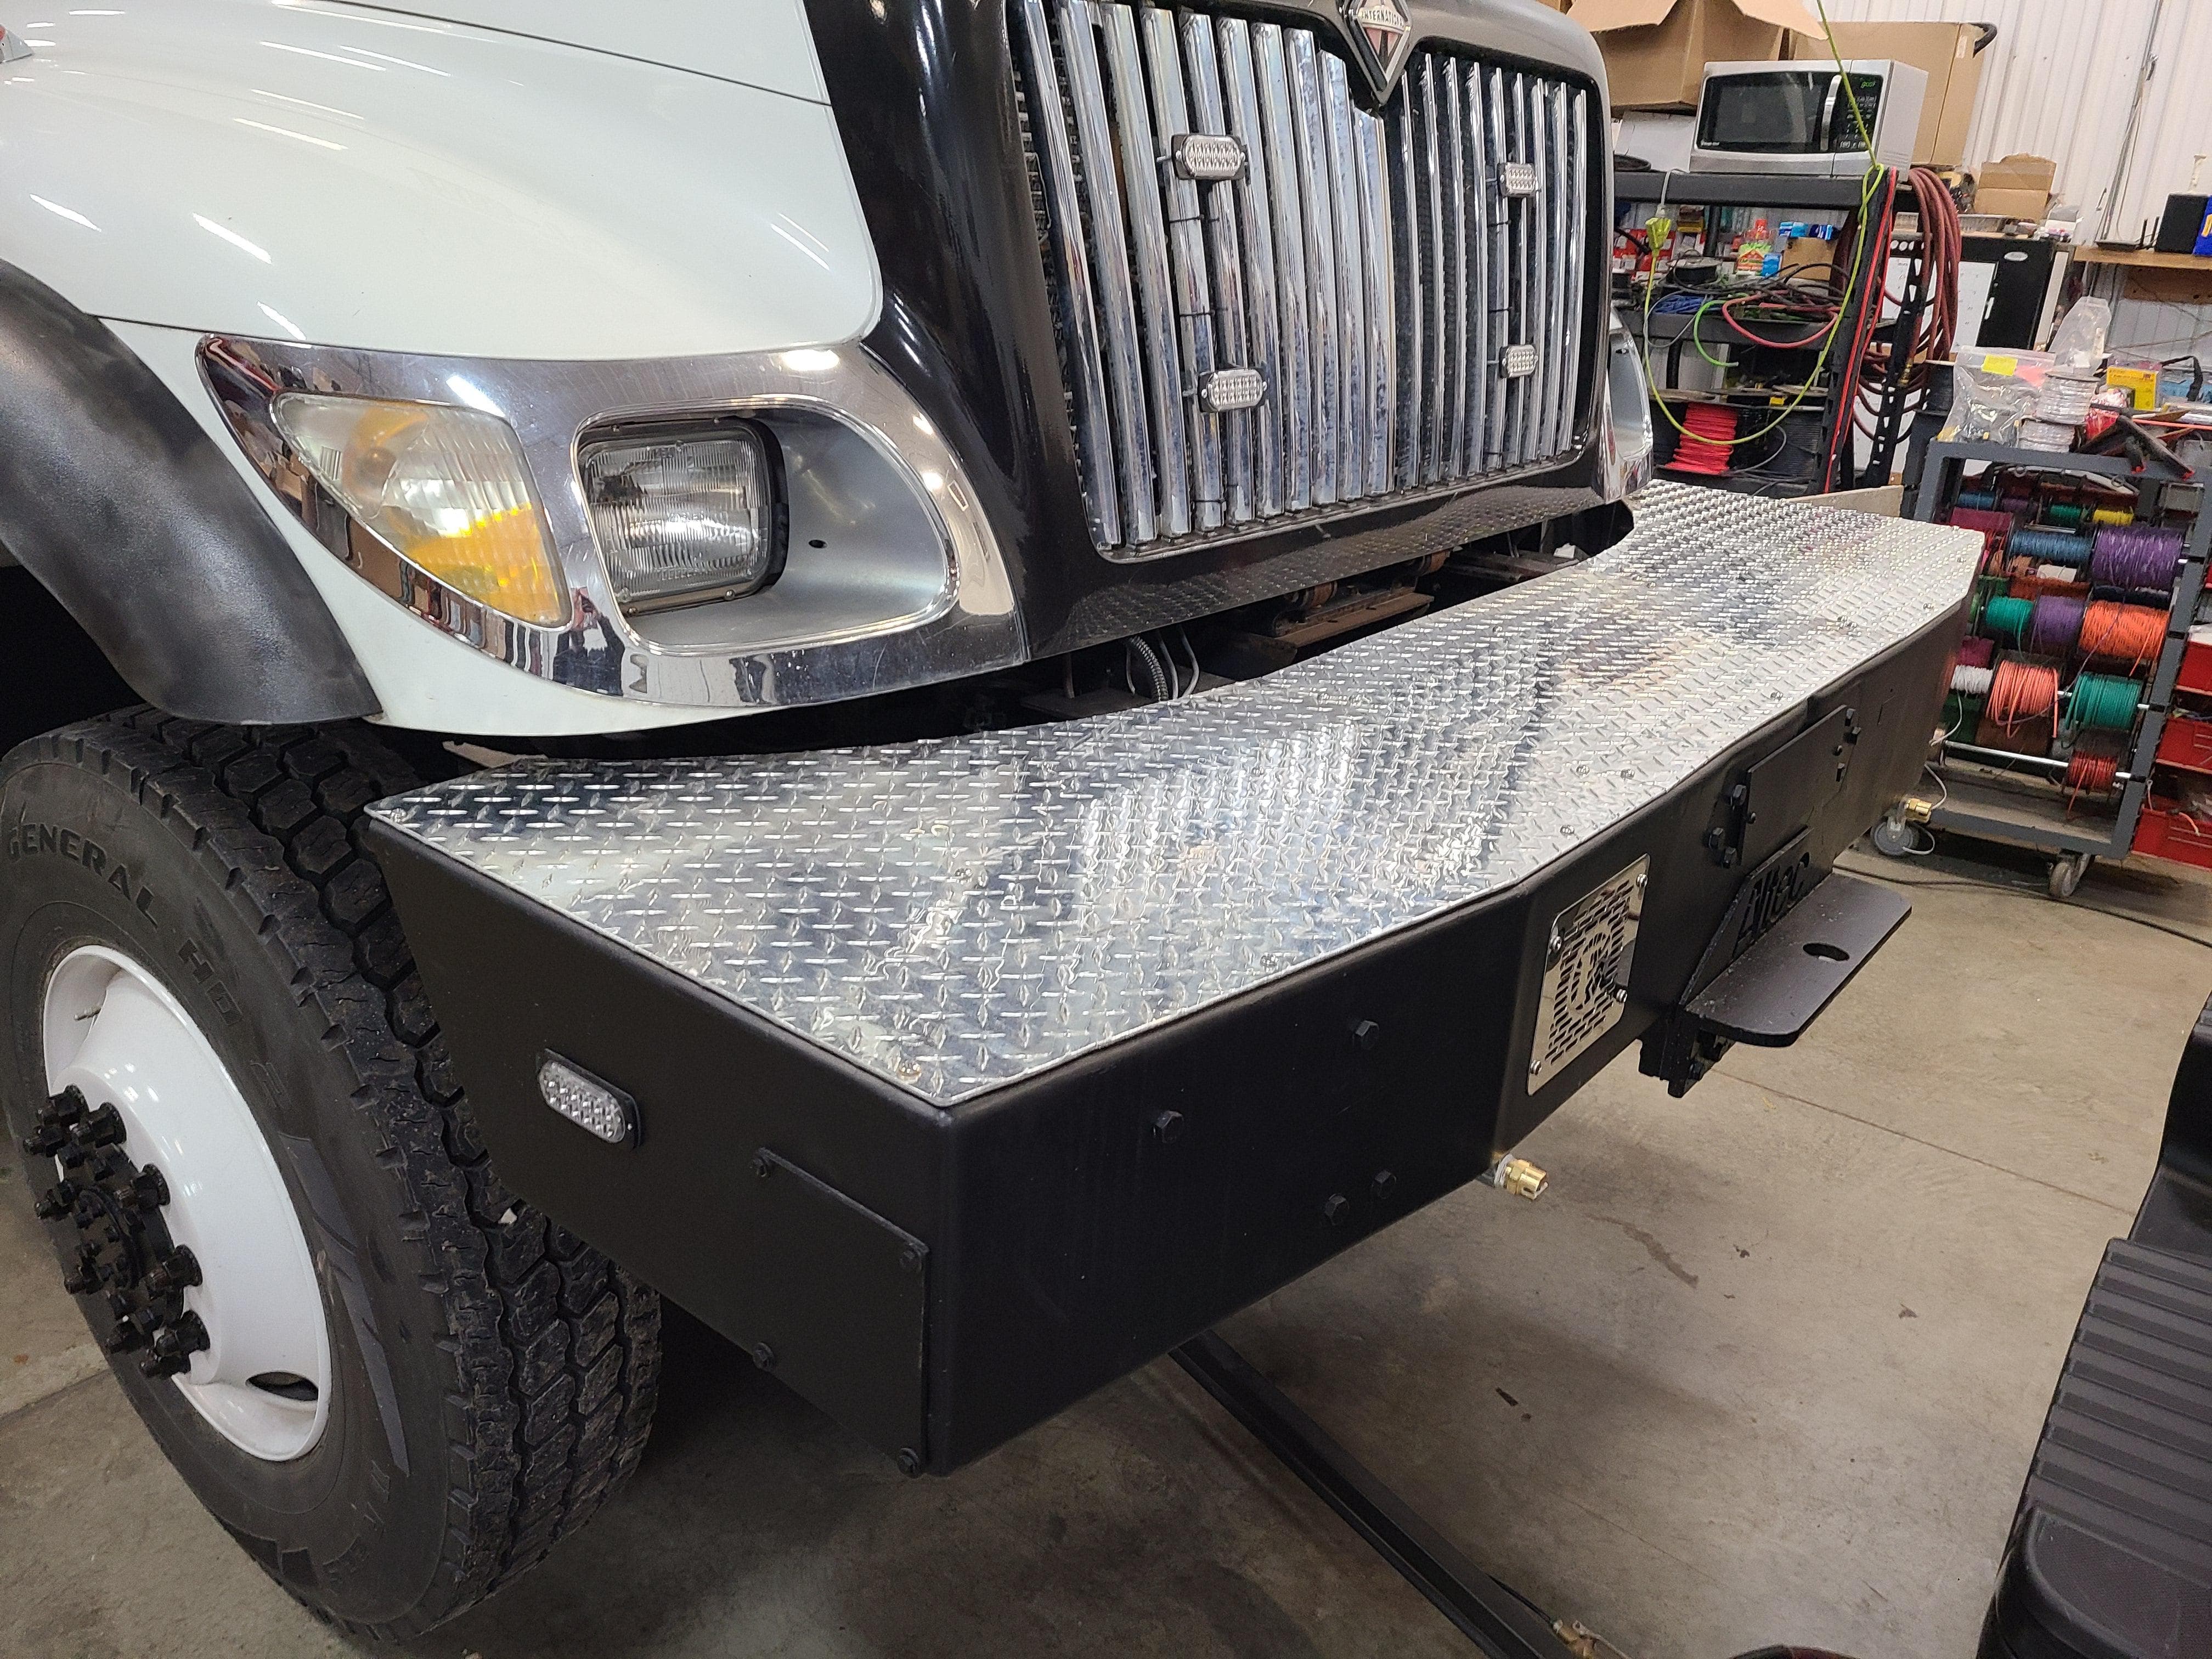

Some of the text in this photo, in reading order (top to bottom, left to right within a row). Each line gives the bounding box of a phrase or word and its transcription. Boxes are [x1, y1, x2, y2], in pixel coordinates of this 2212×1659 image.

[8, 822, 158, 928] GENERAL
[178, 938, 244, 1025] HD
[1733, 852, 1810, 960] Altec
